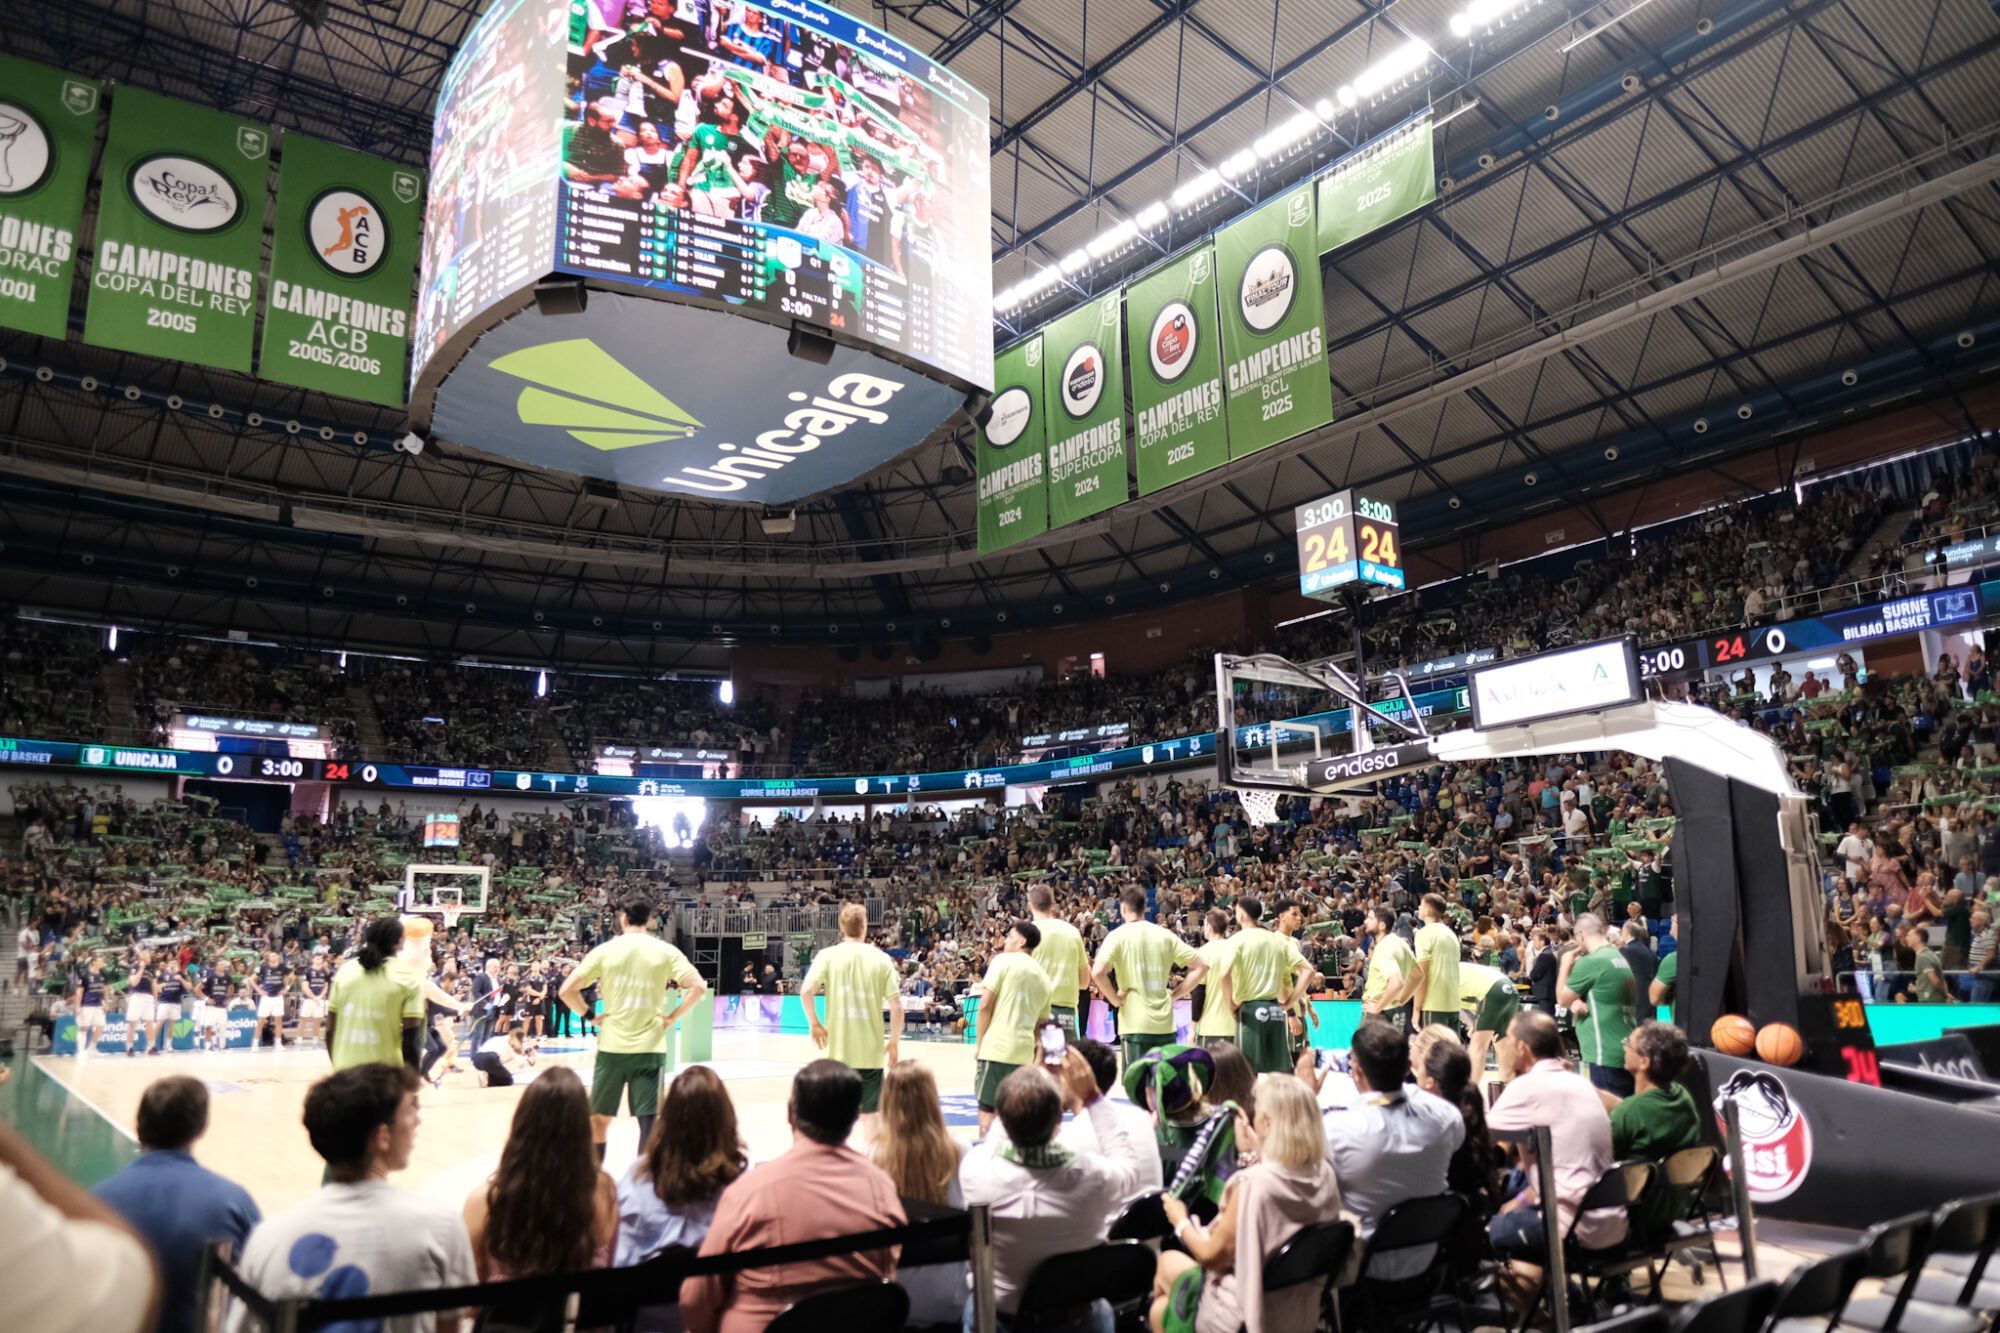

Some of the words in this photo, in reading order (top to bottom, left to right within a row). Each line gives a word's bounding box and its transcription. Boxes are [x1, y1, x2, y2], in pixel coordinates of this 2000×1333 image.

[149, 176, 197, 205] Rey
[162, 171, 207, 195] Copa
[1357, 181, 1392, 212] 2025
[0, 216, 73, 262] ONES
[352, 217, 370, 264] ACB
[0, 248, 60, 278] ORAC
[100, 240, 253, 300] CAMPEONES
[0, 278, 36, 302] 001
[95, 272, 155, 297] COPA
[161, 283, 204, 307] DEL
[209, 294, 252, 317] REY
[802, 291, 828, 305] FALTAS
[147, 307, 197, 333] 2005
[272, 280, 406, 337] CAMPEONES
[781, 297, 812, 318] 3:00
[307, 320, 368, 353] ACB
[289, 340, 381, 376] 2005/2006
[1229, 326, 1321, 391] CAMPEONES
[1261, 378, 1289, 400] BCL
[1138, 378, 1220, 436] CAMPEONES
[1262, 394, 1293, 421] 2025
[662, 372, 905, 492] Unicaja
[1140, 427, 1169, 448] COPA
[1171, 417, 1193, 436] DEL
[1197, 404, 1220, 424] REY
[1050, 417, 1121, 468] CAMPEONES
[1167, 441, 1195, 465] 2025
[980, 452, 1042, 500] CAMPEONES
[1051, 444, 1123, 484] SUPERCOPA
[1075, 475, 1101, 497] 2024
[999, 506, 1022, 527] 2024
[1304, 498, 1344, 527] 3:00
[1360, 497, 1392, 522] 3:00
[1305, 526, 1348, 573] 24
[1361, 525, 1397, 567] 24
[1882, 598, 1929, 619] SURNE
[1843, 622, 1884, 641] BILBAO
[1886, 615, 1931, 634] BASKET
[1715, 637, 1746, 662] 24
[1766, 629, 1786, 654] 0
[1401, 706, 1434, 721] BAKET
[11, 751, 53, 763] BASKET
[115, 751, 177, 769] UNICAJA
[217, 756, 233, 774] 0
[262, 760, 303, 777] 3:00
[1324, 751, 1399, 781] endesa
[325, 763, 349, 780] 24
[362, 765, 377, 783] 0
[413, 777, 438, 785] BILBAO
[438, 778, 465, 787] BASKET
[438, 769, 466, 779] SURNE
[765, 780, 795, 788] UNICAJA
[740, 788, 764, 797] SURNE
[765, 788, 790, 797] BILBAO
[791, 787, 819, 796] BASKET
[436, 824, 458, 838] 24
[1740, 1144, 1791, 1176] isi
